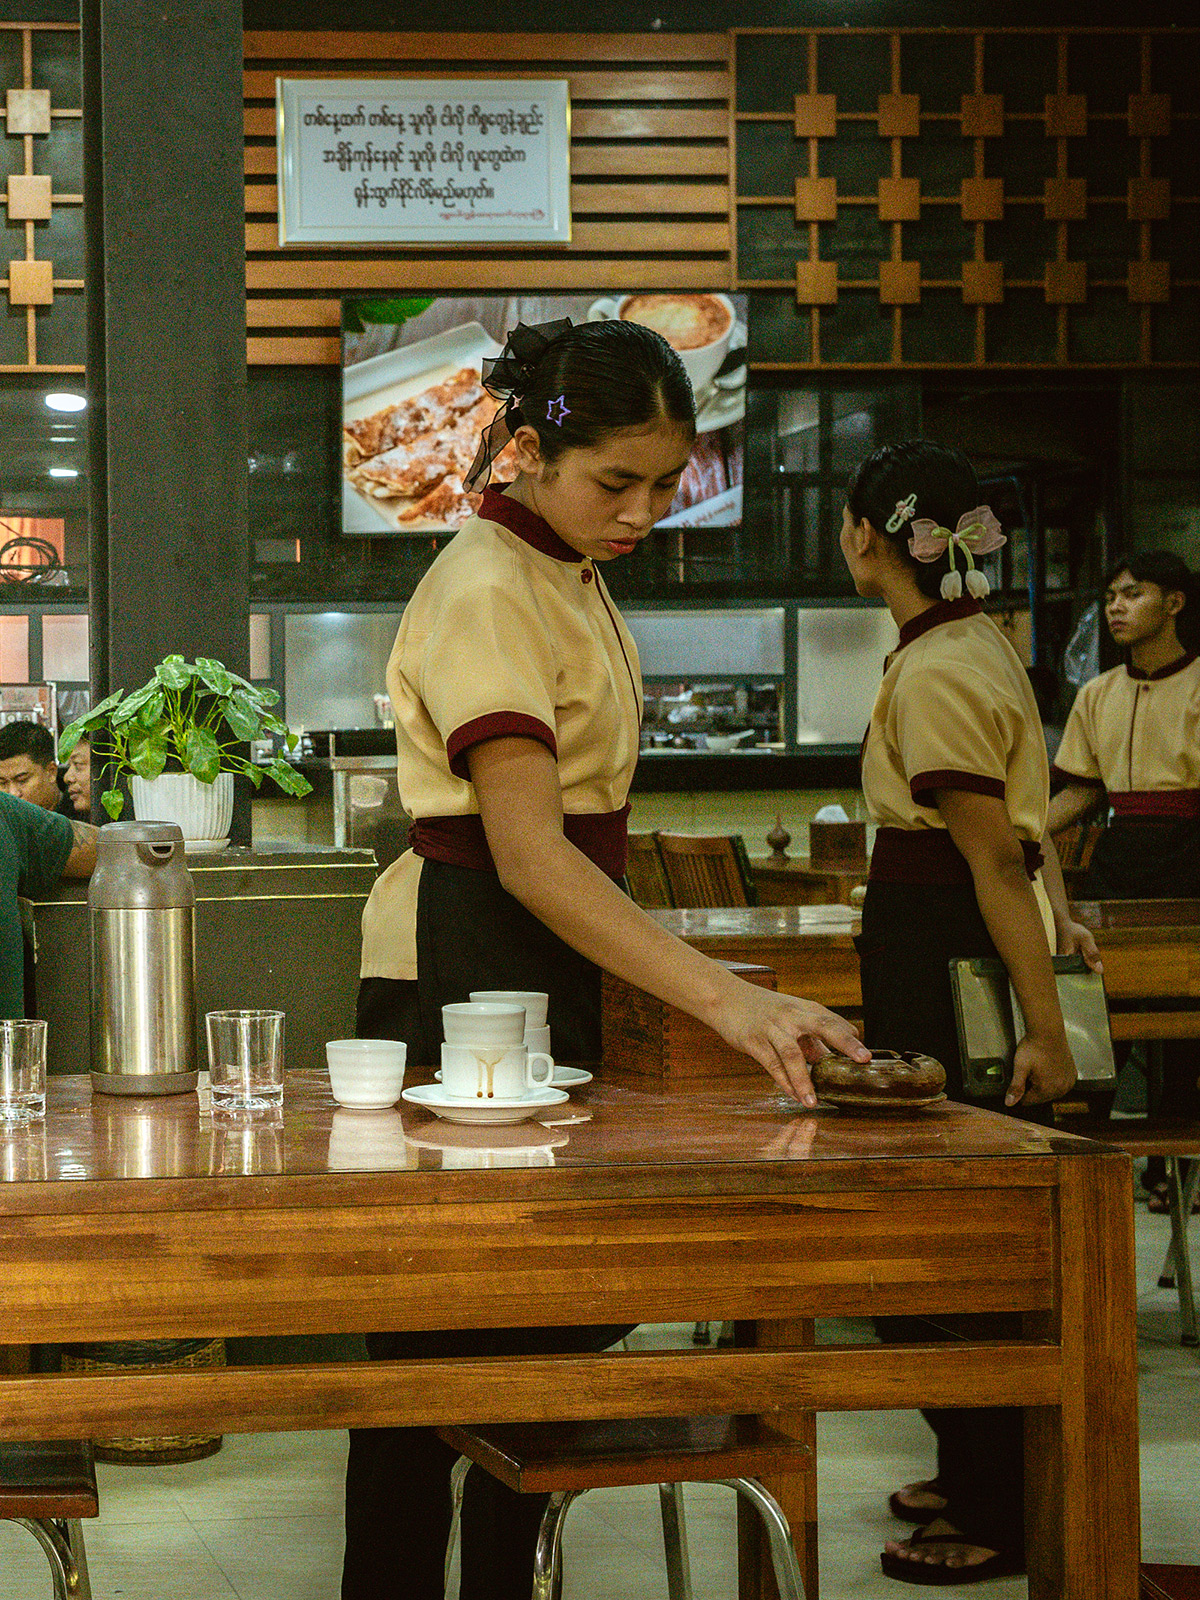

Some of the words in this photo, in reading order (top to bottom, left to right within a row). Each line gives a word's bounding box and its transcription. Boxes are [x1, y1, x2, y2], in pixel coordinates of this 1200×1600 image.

[369, 105, 406, 134] တစ်နေ့
[441, 105, 464, 134] ငါလို
[440, 141, 464, 171] ငါလို
